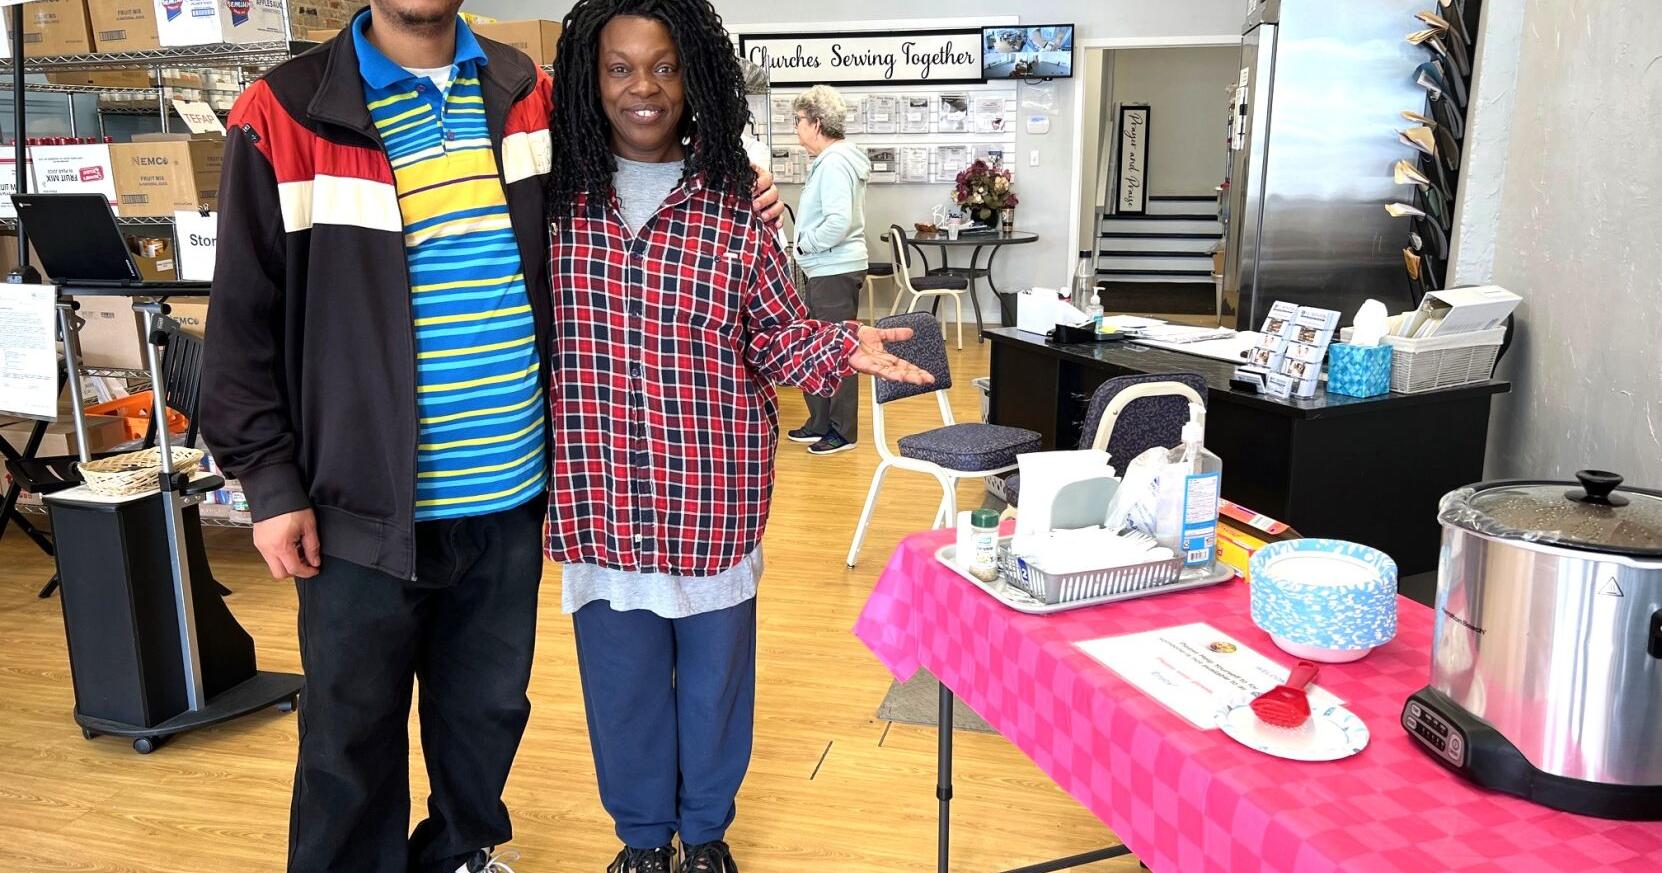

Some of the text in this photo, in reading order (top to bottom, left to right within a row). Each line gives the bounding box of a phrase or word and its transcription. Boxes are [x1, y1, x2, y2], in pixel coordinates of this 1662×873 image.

[750, 41, 976, 80] Churches Serving Together
[182, 113, 215, 124] TEFAP
[1122, 112, 1143, 208] Prayer and Praise
[189, 233, 217, 247] Stor
